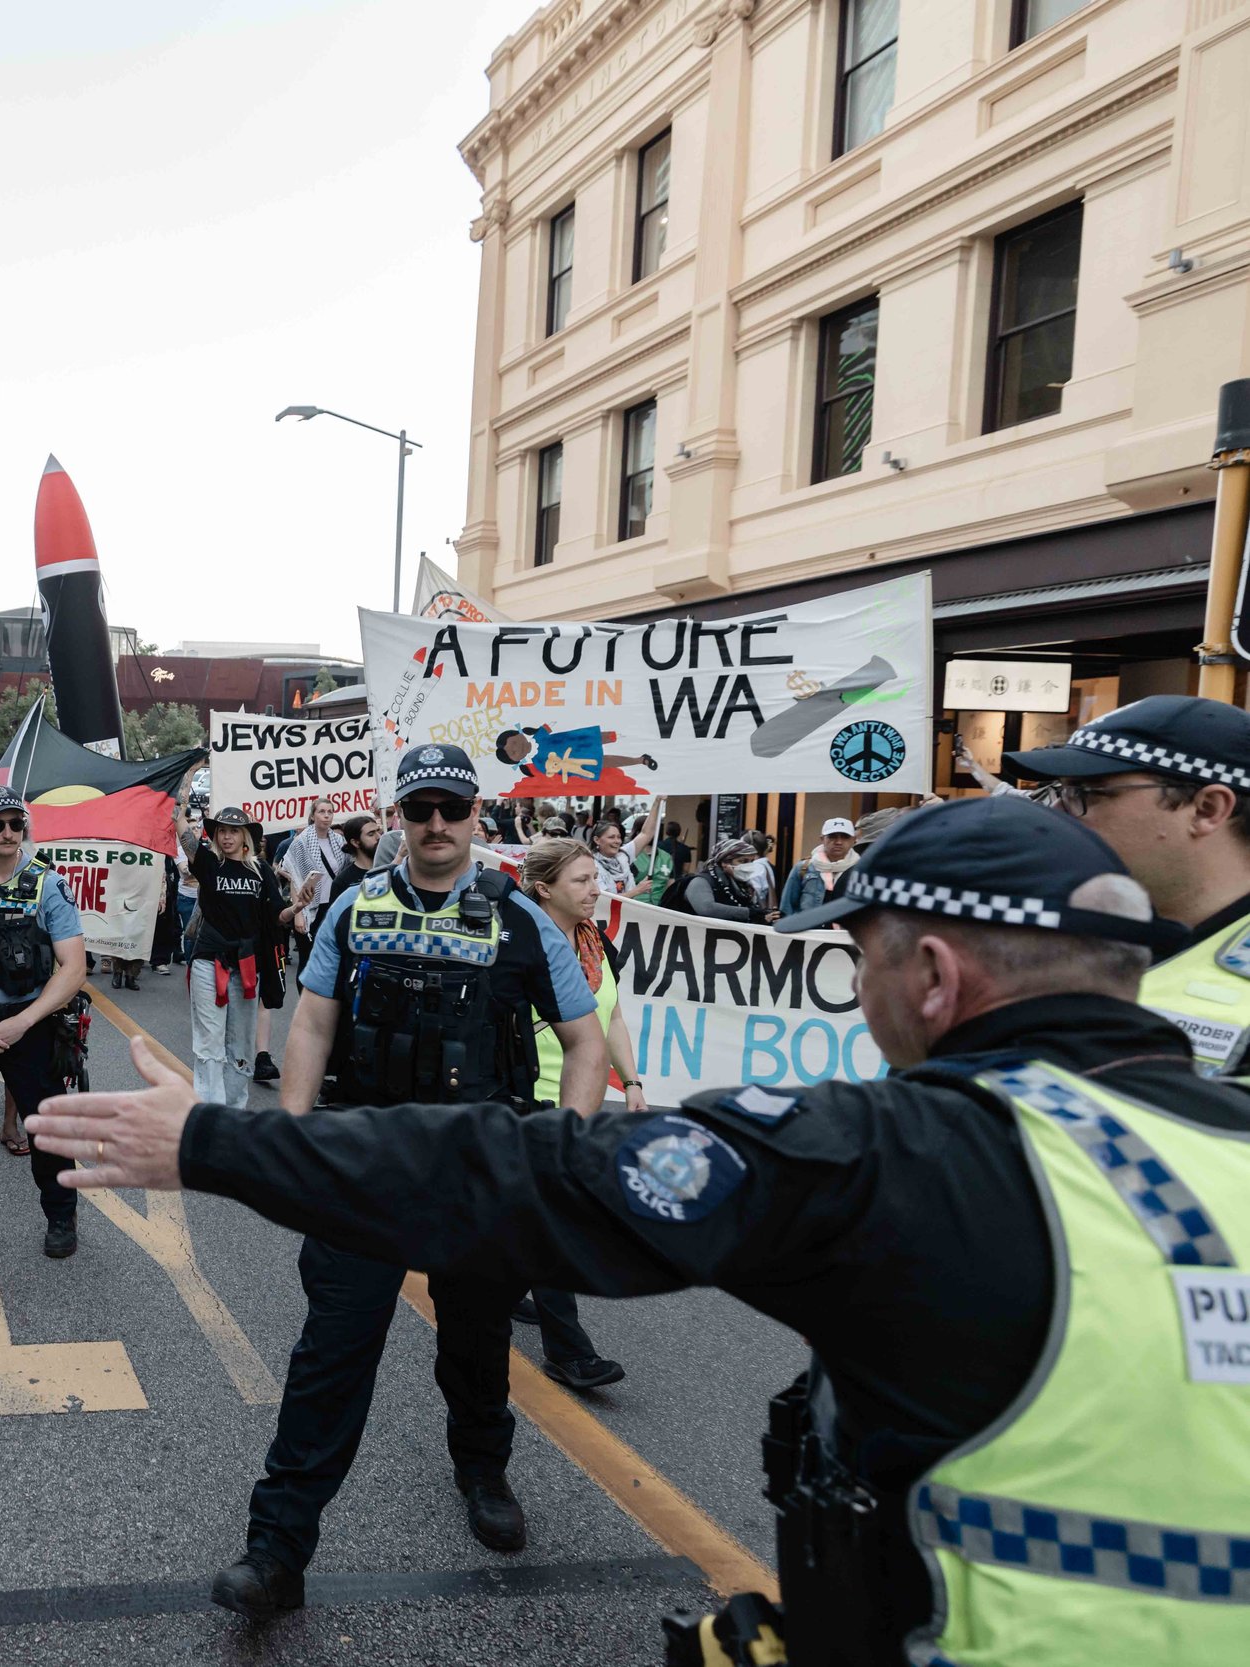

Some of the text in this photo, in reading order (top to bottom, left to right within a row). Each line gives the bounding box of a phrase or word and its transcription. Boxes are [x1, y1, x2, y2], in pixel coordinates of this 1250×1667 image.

[457, 599, 489, 623] PRO
[423, 613, 794, 678] A FUTURE
[391, 670, 416, 715] COLLIE
[404, 692, 426, 726] BOUND
[466, 679, 623, 708] MADE IN
[648, 673, 766, 739] WA
[211, 723, 307, 753] JEWS
[430, 706, 506, 745] ROGER
[833, 730, 852, 747] WA
[830, 747, 905, 782] COLLECTIVE
[326, 788, 378, 814] SRAE
[106, 850, 154, 867] FOR
[596, 919, 862, 1014] WARMO
[637, 1003, 891, 1087] IN BOO
[620, 1164, 686, 1221] POLICE
